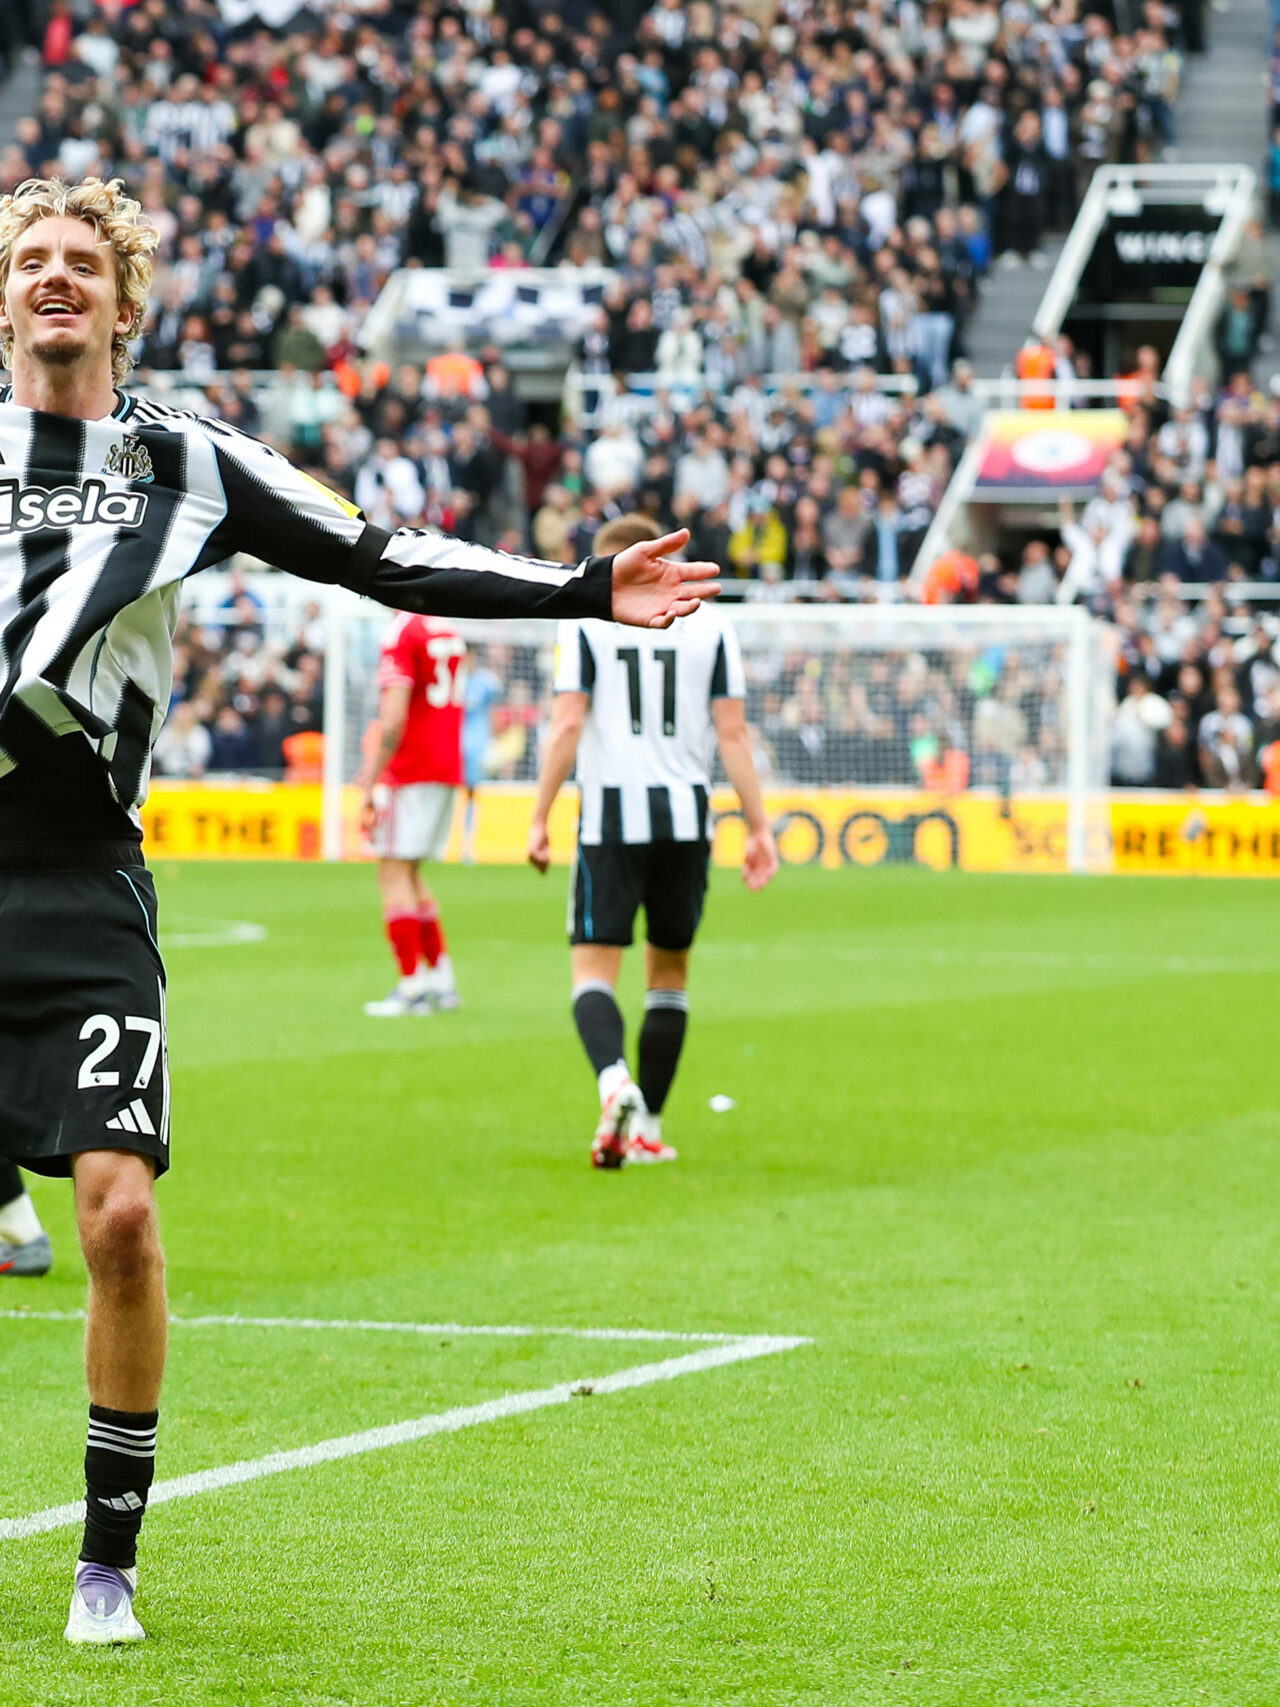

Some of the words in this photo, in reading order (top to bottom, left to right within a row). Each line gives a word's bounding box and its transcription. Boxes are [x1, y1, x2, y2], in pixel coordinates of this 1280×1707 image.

[17, 484, 141, 528] sela
[617, 648, 676, 737] 11
[78, 1014, 161, 1090] 27
